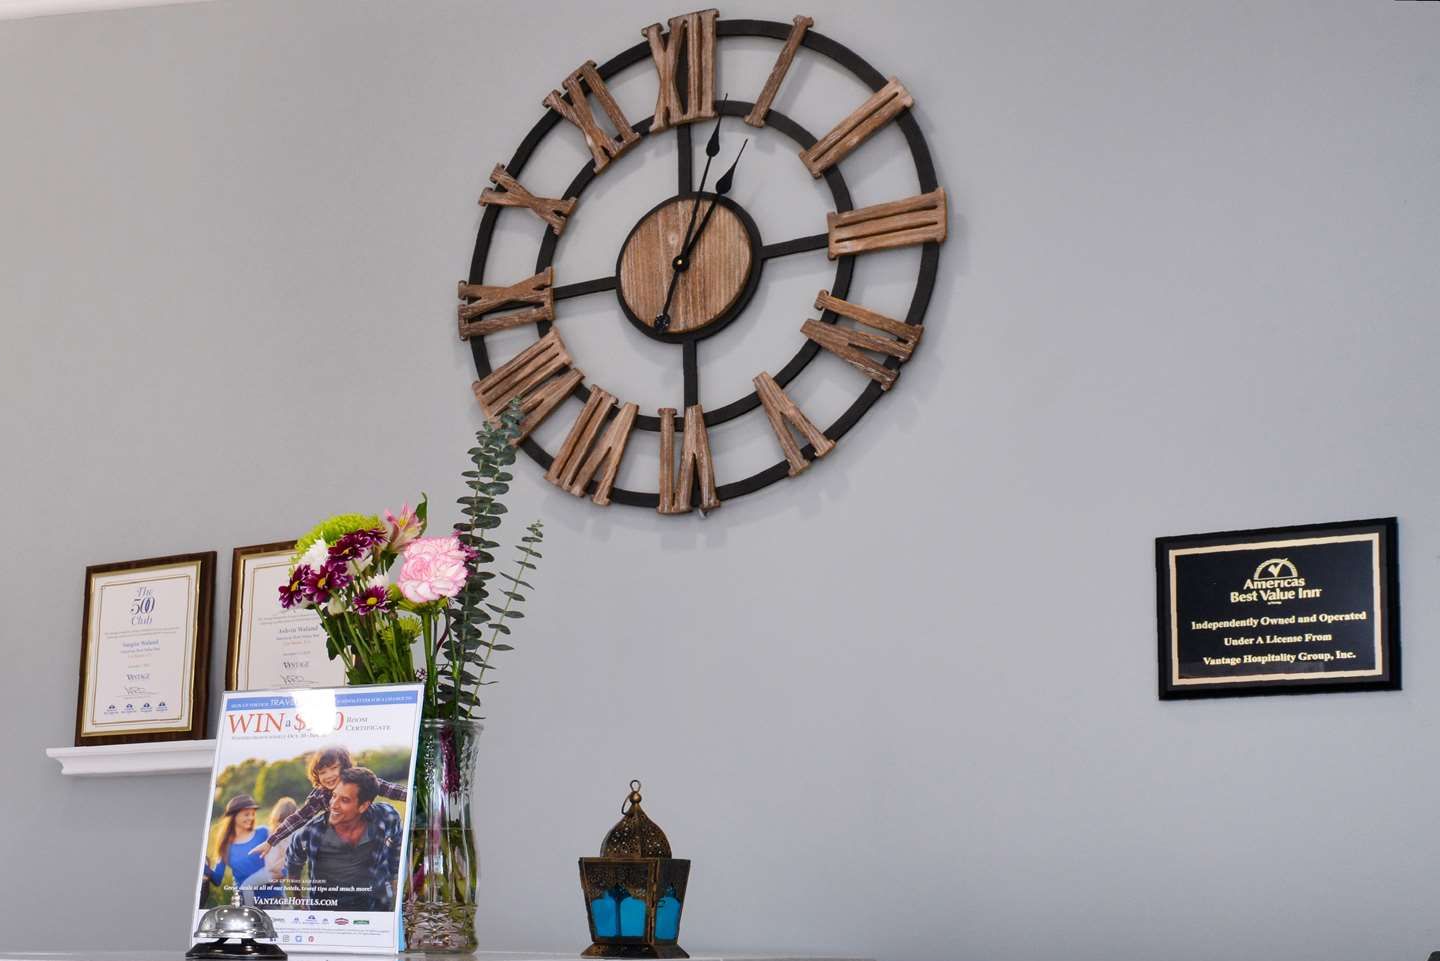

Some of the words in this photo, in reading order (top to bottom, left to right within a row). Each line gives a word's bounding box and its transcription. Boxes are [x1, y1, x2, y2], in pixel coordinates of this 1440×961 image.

[641, 8, 720, 135] XII
[1243, 578, 1305, 590] Americas
[1230, 591, 1258, 603] Best
[1260, 588, 1295, 601] Value
[1298, 587, 1322, 599] Inn
[1191, 617, 1259, 631] Independently
[1260, 616, 1295, 626] Owned
[1298, 615, 1317, 623] and
[1319, 611, 1367, 623] Operated
[1224, 637, 1253, 646] Under
[1256, 636, 1264, 645] A
[1266, 634, 1303, 644] License
[1305, 633, 1332, 642] From
[1203, 655, 1241, 667] Vantage
[1243, 652, 1296, 664] Hospitality
[1298, 650, 1334, 662] Group,
[1336, 649, 1356, 660] Inc.
[227, 711, 286, 734] WIN
[285, 719, 292, 728] a
[253, 896, 338, 906] VANTAGEHOTELS.COM
